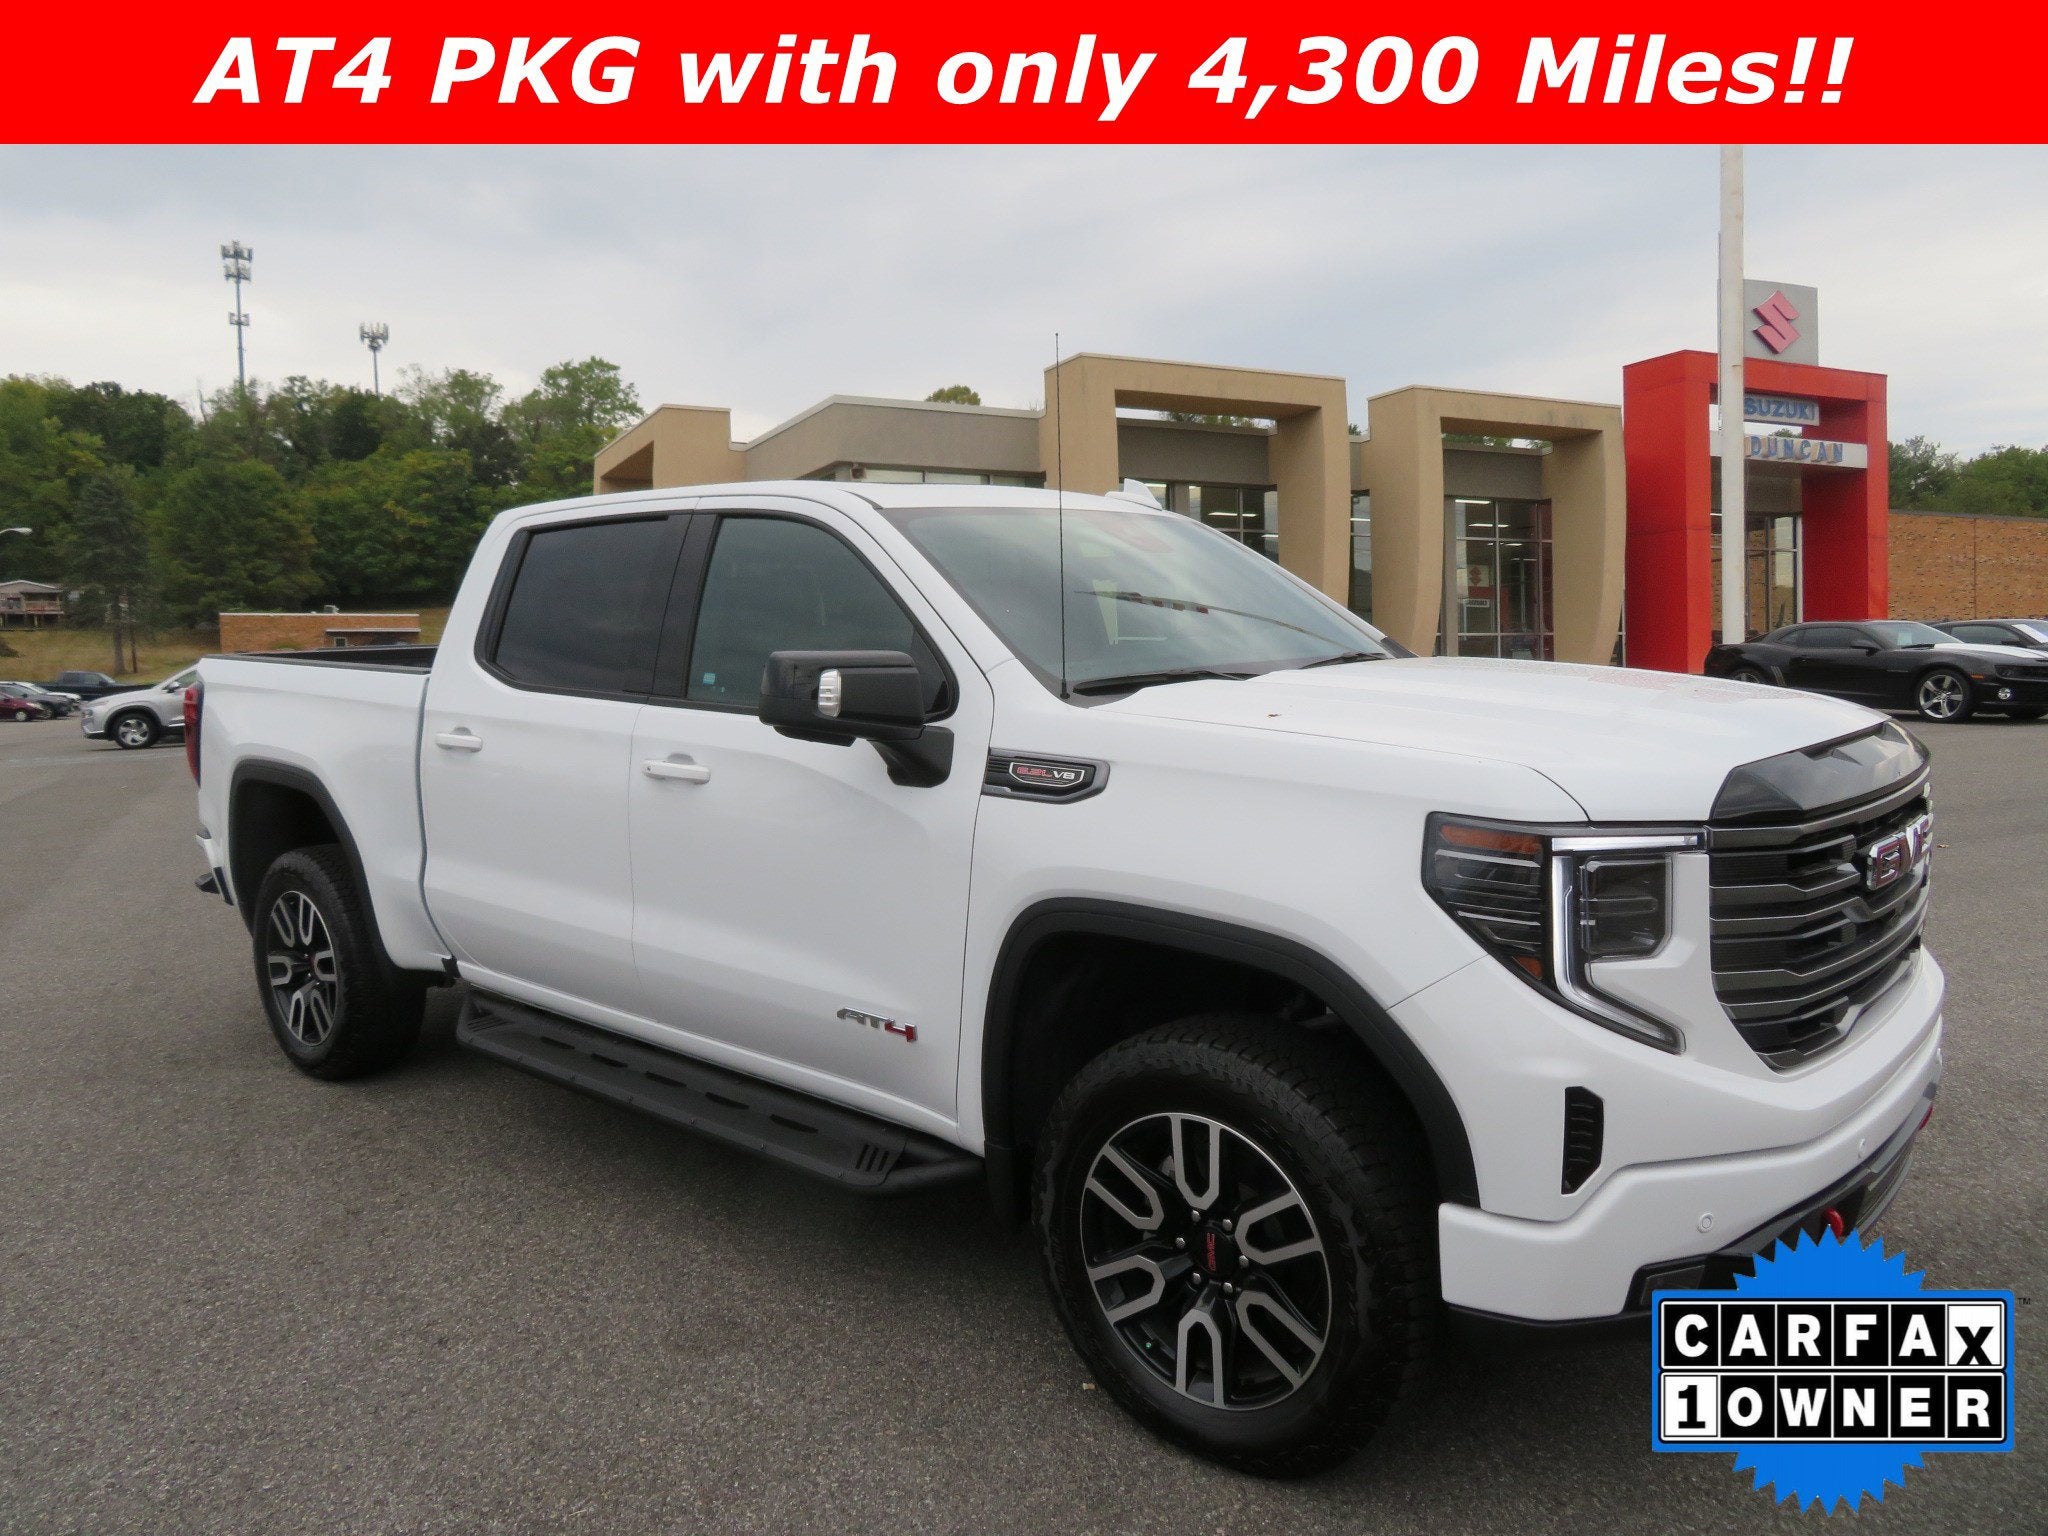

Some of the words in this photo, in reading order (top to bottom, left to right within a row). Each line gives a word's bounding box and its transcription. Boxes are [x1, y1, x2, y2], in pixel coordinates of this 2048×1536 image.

[1744, 395, 1817, 421] SUZUKI
[1748, 435, 1844, 464] DUNCAN
[836, 1006, 918, 1043] AT4
